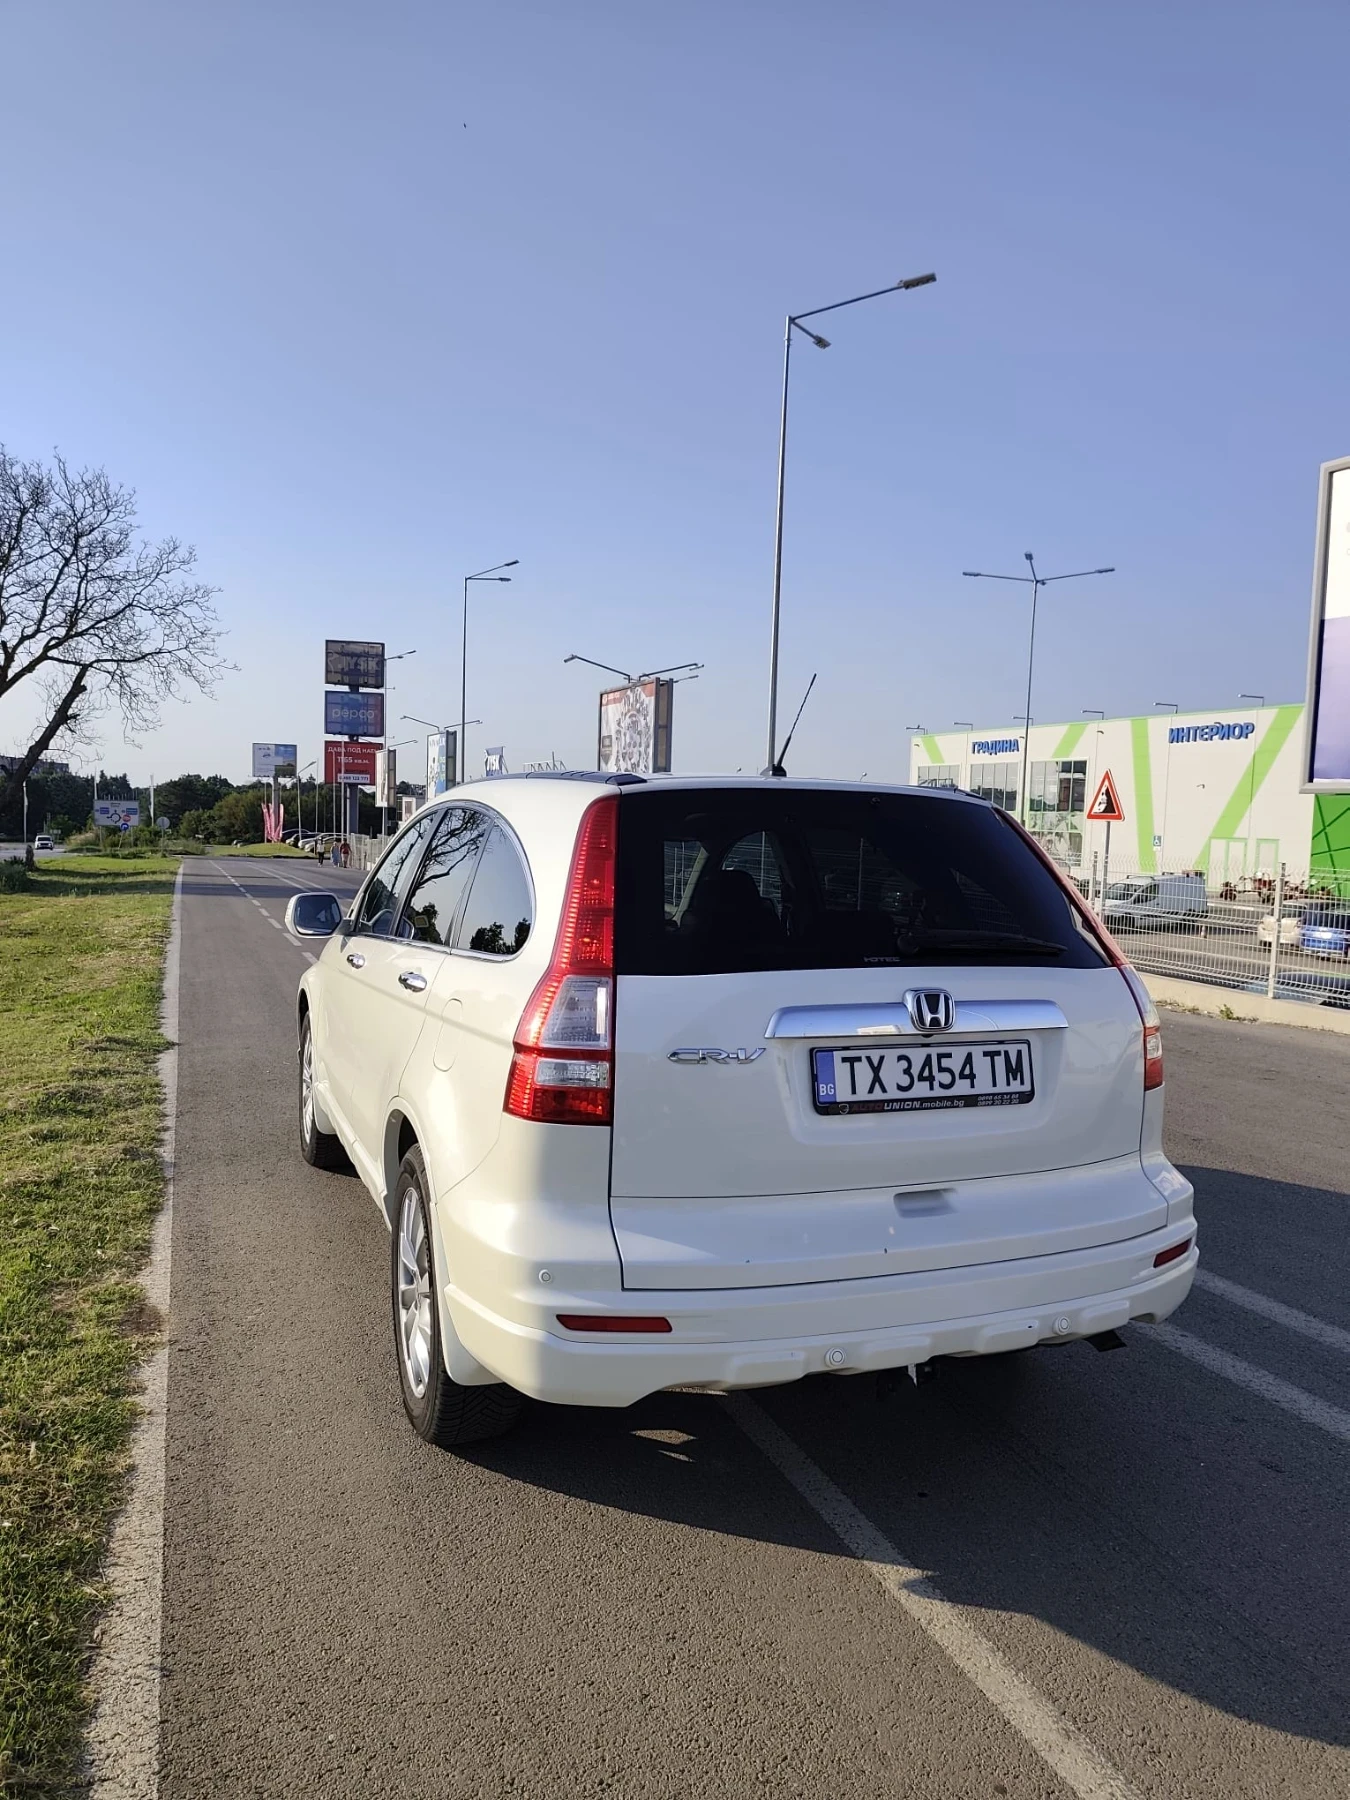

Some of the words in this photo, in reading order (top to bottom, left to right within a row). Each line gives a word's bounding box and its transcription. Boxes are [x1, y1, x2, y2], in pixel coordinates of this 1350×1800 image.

[332, 709, 375, 720] pepco
[1168, 722, 1256, 744] ИНТЕРИОР
[971, 738, 1020, 756] ГРАДИНА
[667, 1047, 767, 1065] CR-V
[841, 1055, 888, 1095] TX
[896, 1052, 977, 1092] 3454
[982, 1049, 1025, 1088] TM
[819, 1083, 835, 1096] BG
